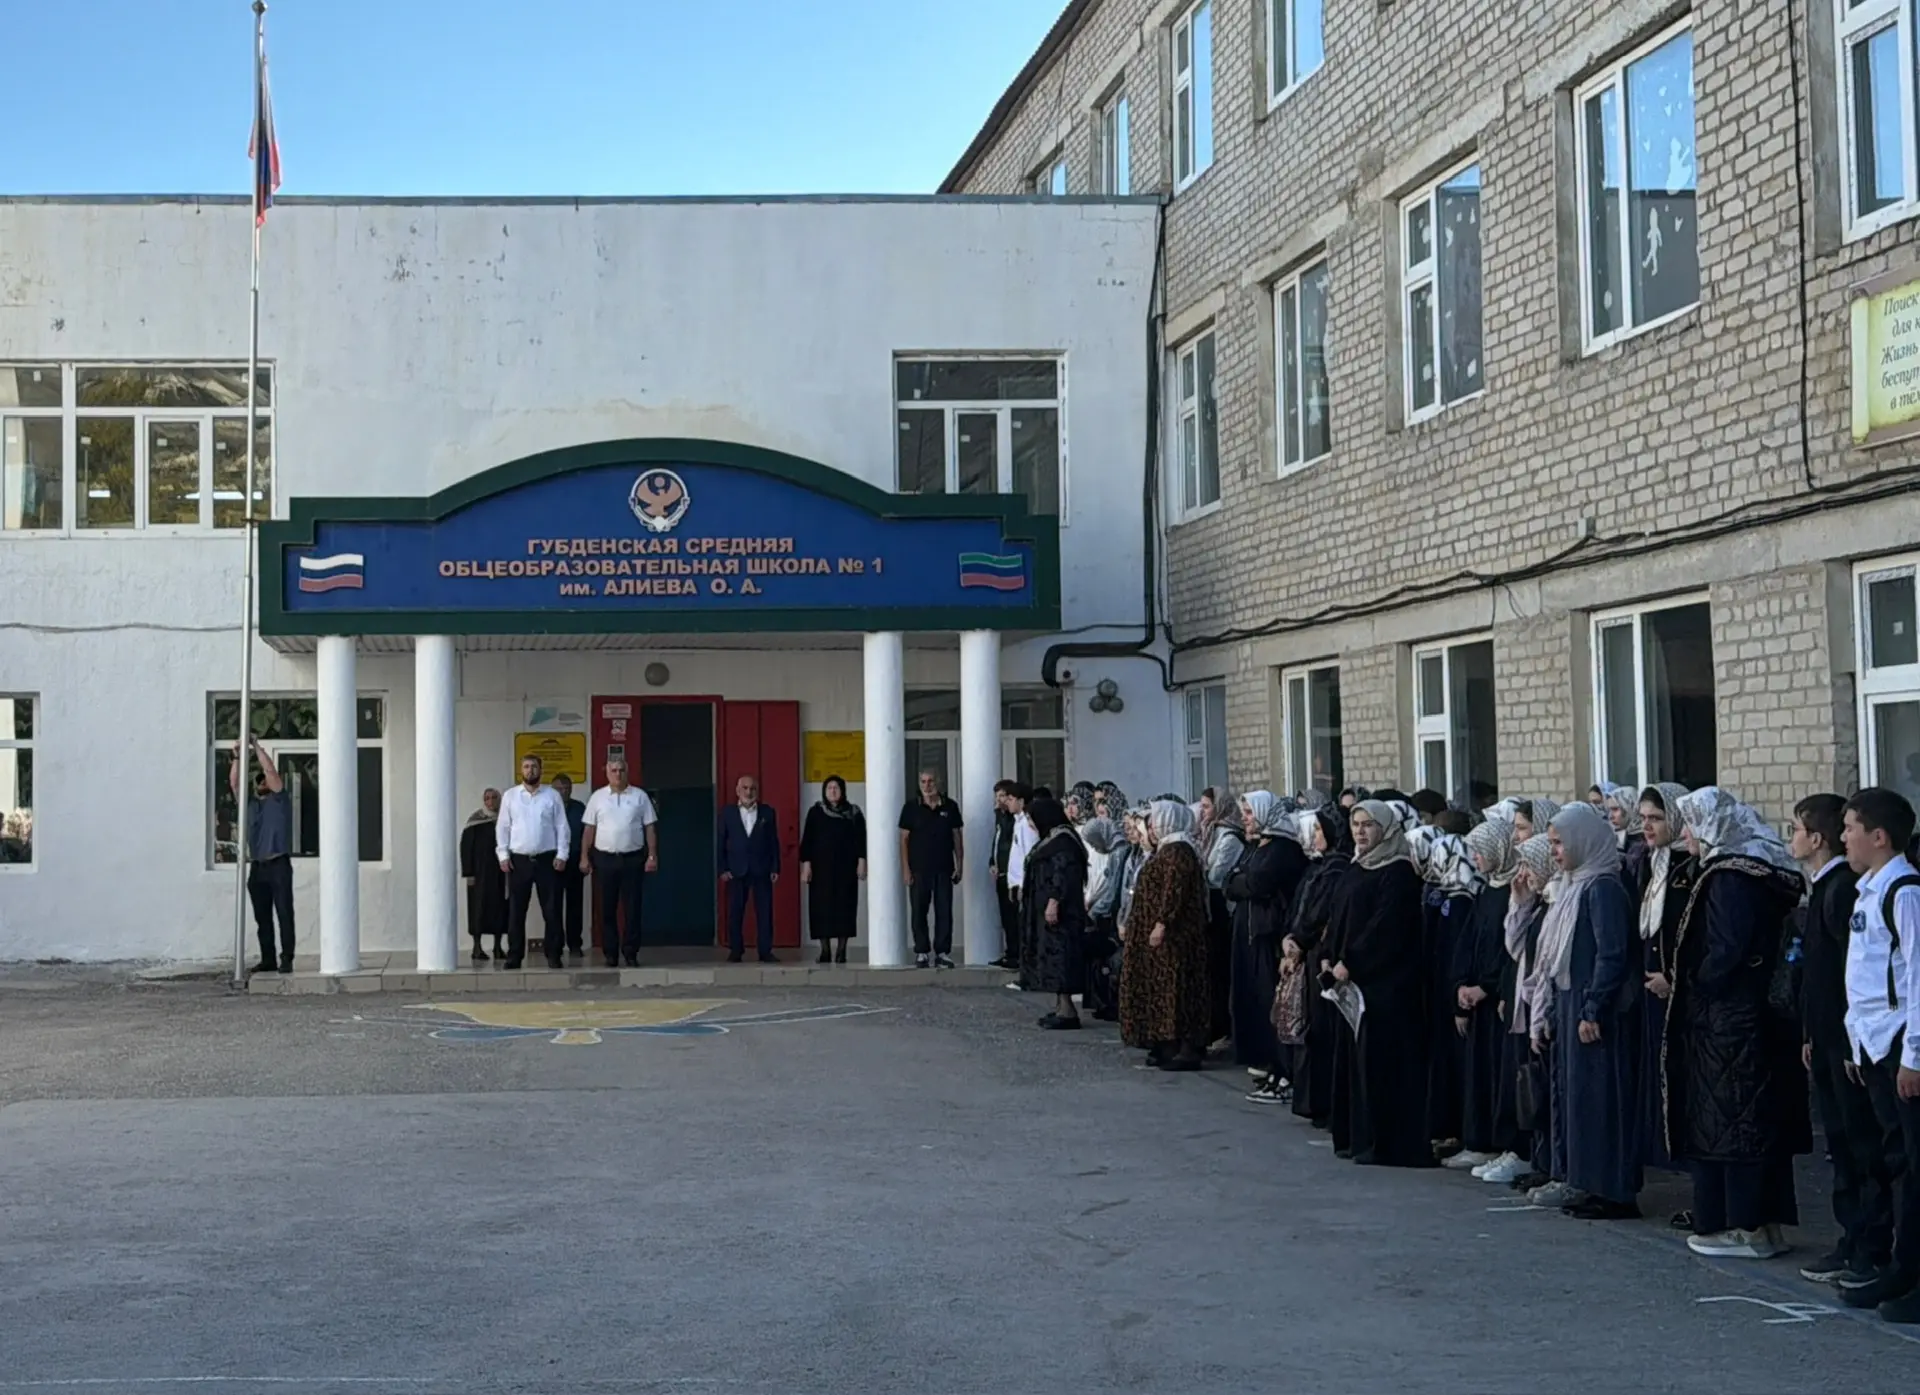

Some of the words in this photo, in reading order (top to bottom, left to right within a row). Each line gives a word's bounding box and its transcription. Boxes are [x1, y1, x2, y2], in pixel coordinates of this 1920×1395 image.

[1884, 292, 1919, 316] Поиск
[1892, 318, 1912, 337] для
[1881, 343, 1919, 365] Жизнь
[527, 537, 678, 557] ГУБДЕНСКАЯ
[685, 537, 794, 556] СРЕДНЯЯ
[439, 558, 740, 579] ОБЩЕОБРАЗОВАТЕЛЬНАЯ
[746, 557, 831, 575] ШКОЛА
[837, 557, 864, 574] №
[871, 557, 883, 574] 1
[559, 582, 597, 596] им.
[603, 578, 697, 596] АЛИЕВА
[710, 578, 733, 595] О.
[740, 577, 763, 595] А.
